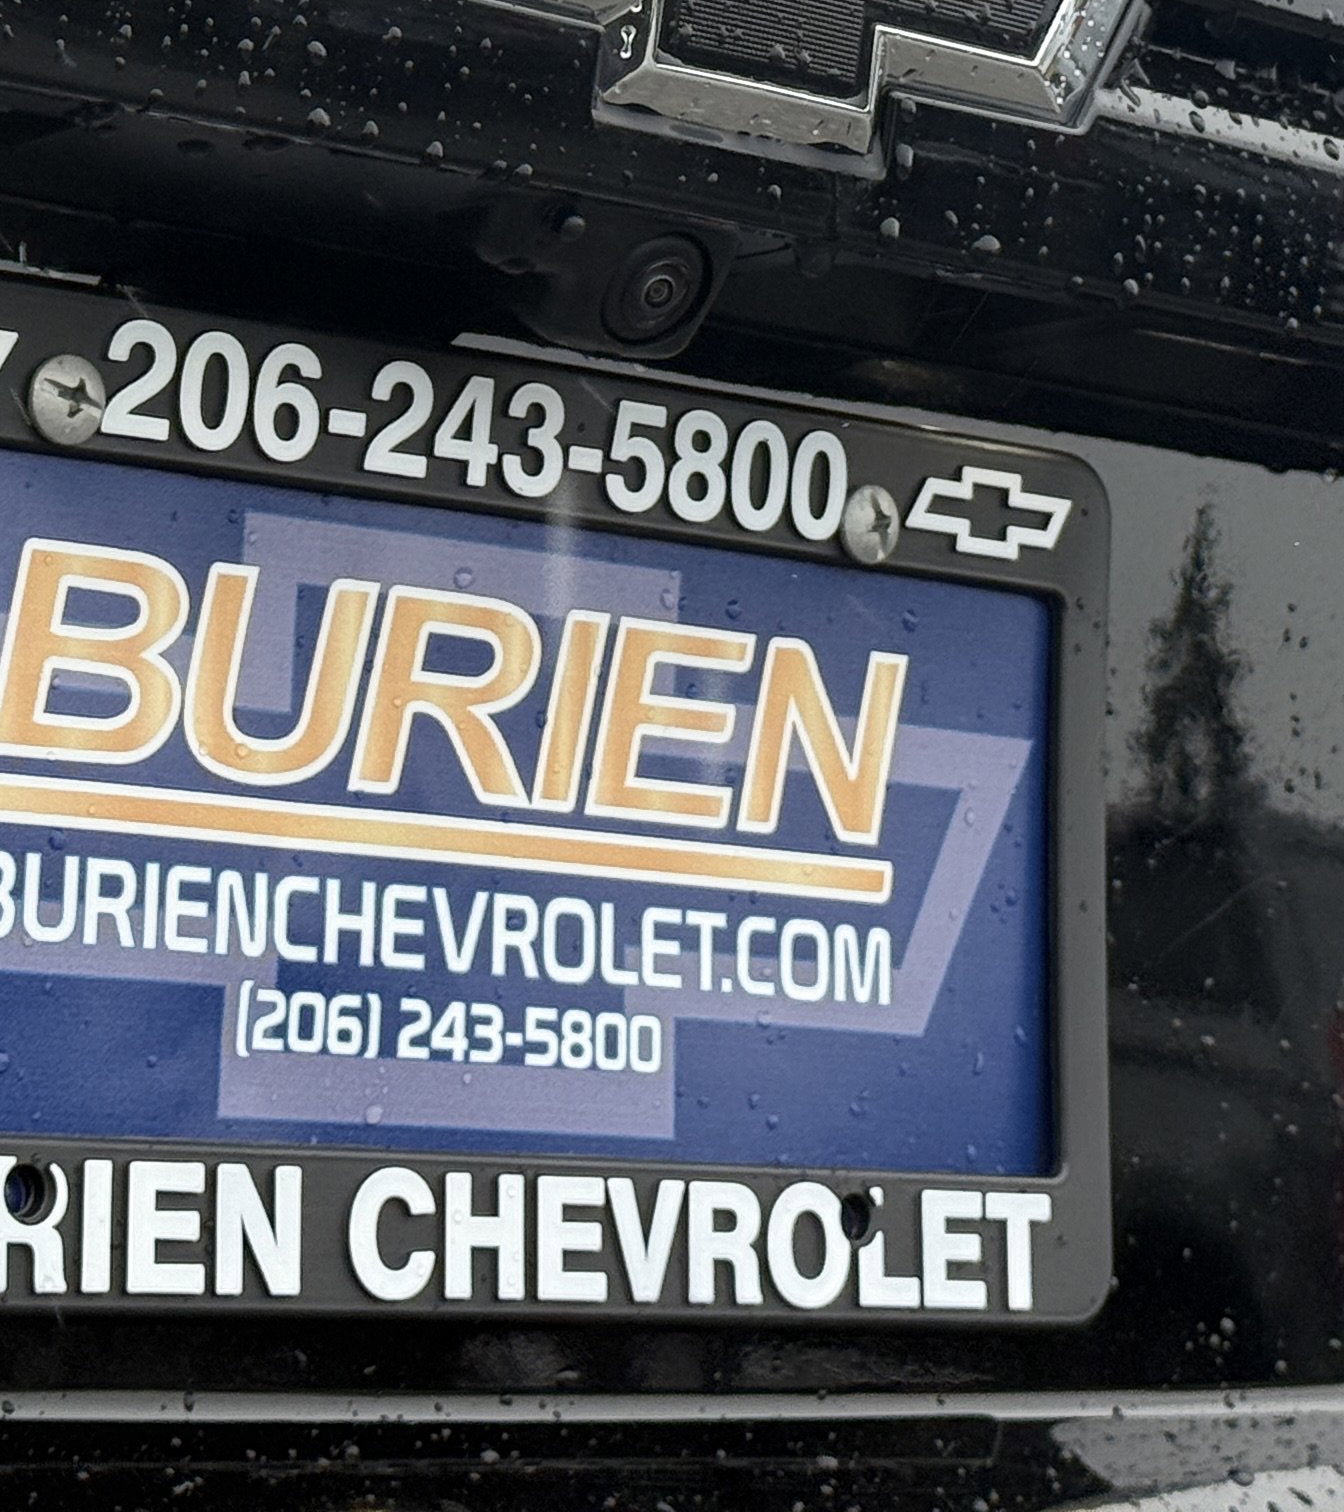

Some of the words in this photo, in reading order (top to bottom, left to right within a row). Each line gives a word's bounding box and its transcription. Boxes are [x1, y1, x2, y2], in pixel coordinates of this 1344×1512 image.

[99, 322, 848, 543] 206-243-5800
[234, 981, 382, 1058] (206)
[396, 995, 661, 1074] 243-5800
[348, 1165, 1052, 1311] CHEVROLET
